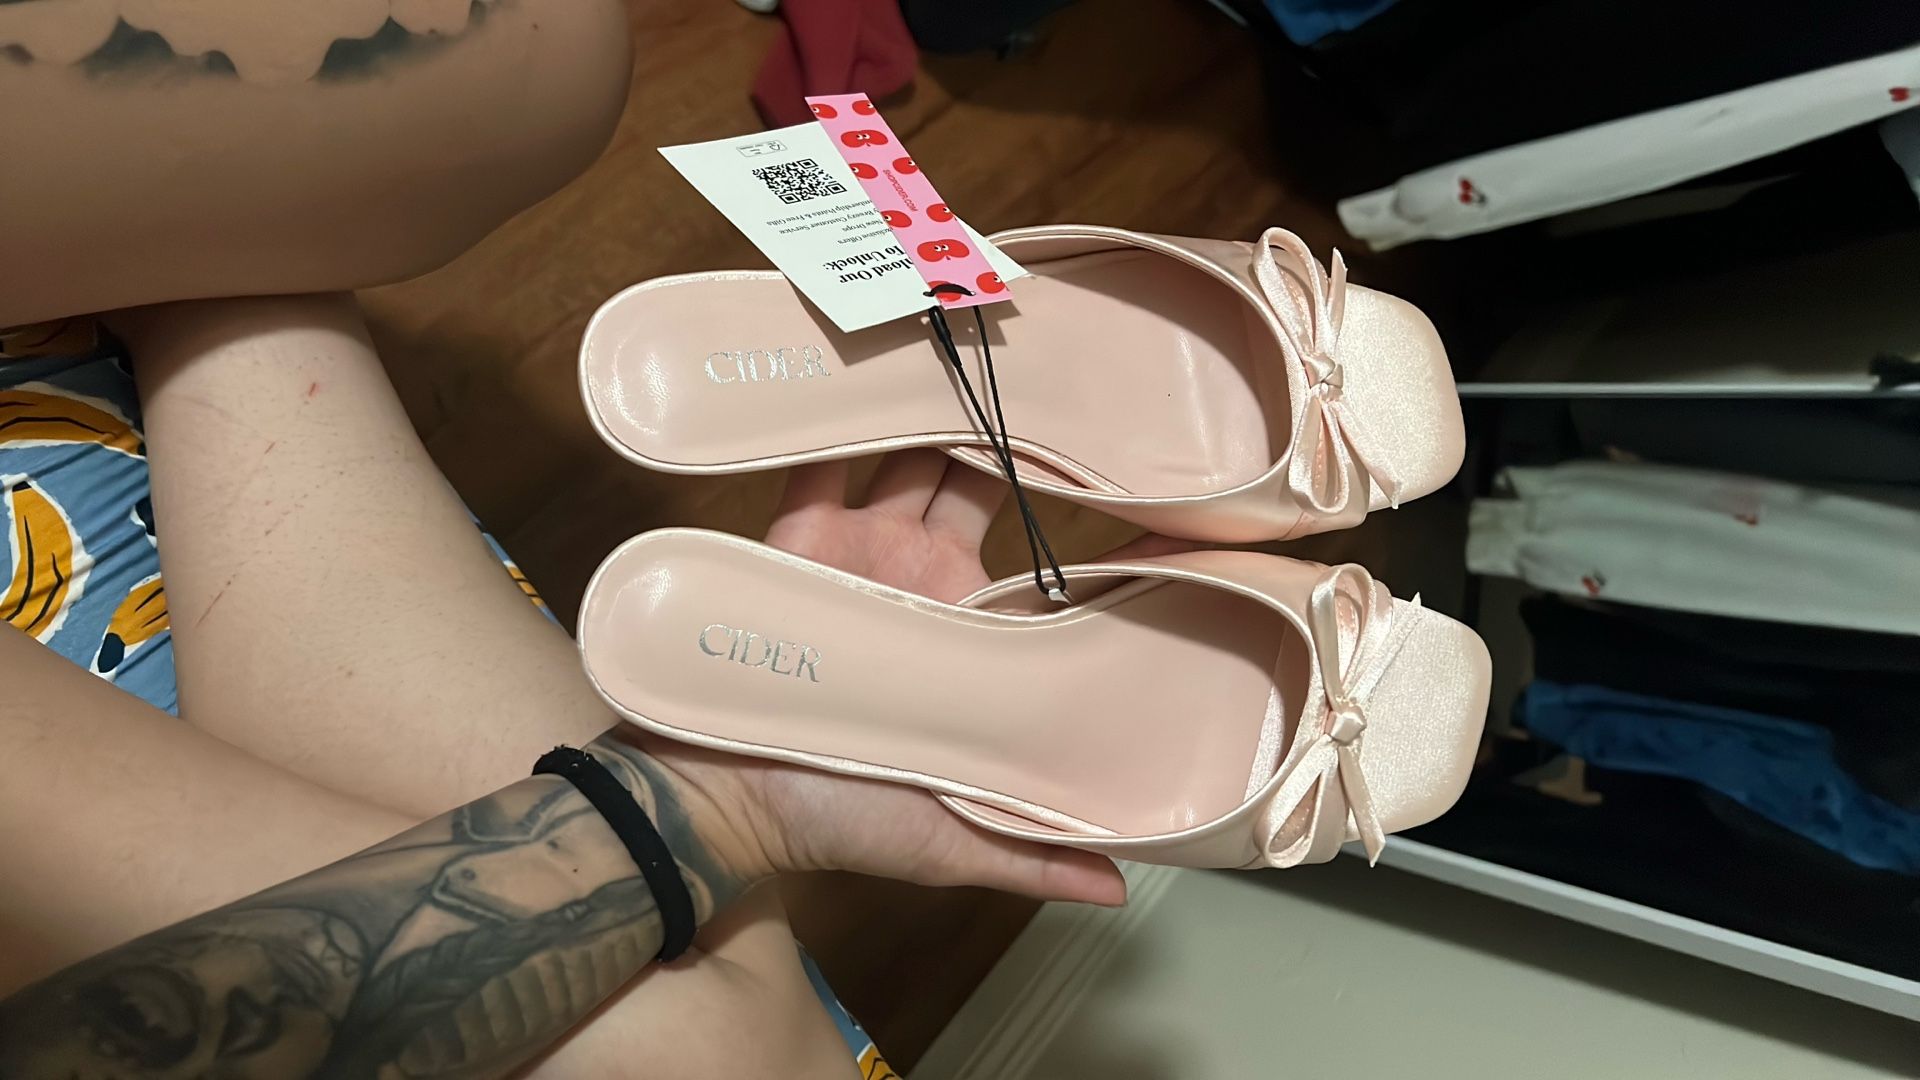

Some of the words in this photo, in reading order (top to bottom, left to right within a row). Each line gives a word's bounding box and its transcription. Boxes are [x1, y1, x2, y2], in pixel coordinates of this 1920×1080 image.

[835, 199, 873, 212] mbership
[786, 214, 805, 225] Free
[812, 209, 837, 219] Points
[766, 218, 787, 227] Gifts
[810, 216, 848, 229] Customer
[842, 220, 867, 232] Drops
[779, 224, 811, 235] Service
[837, 235, 863, 245] Offers
[884, 245, 906, 256] To
[822, 250, 887, 272] Unlock:
[872, 257, 914, 277] nload
[839, 269, 873, 284] Our
[704, 344, 832, 384] CIDER
[698, 623, 822, 683] CIDER
